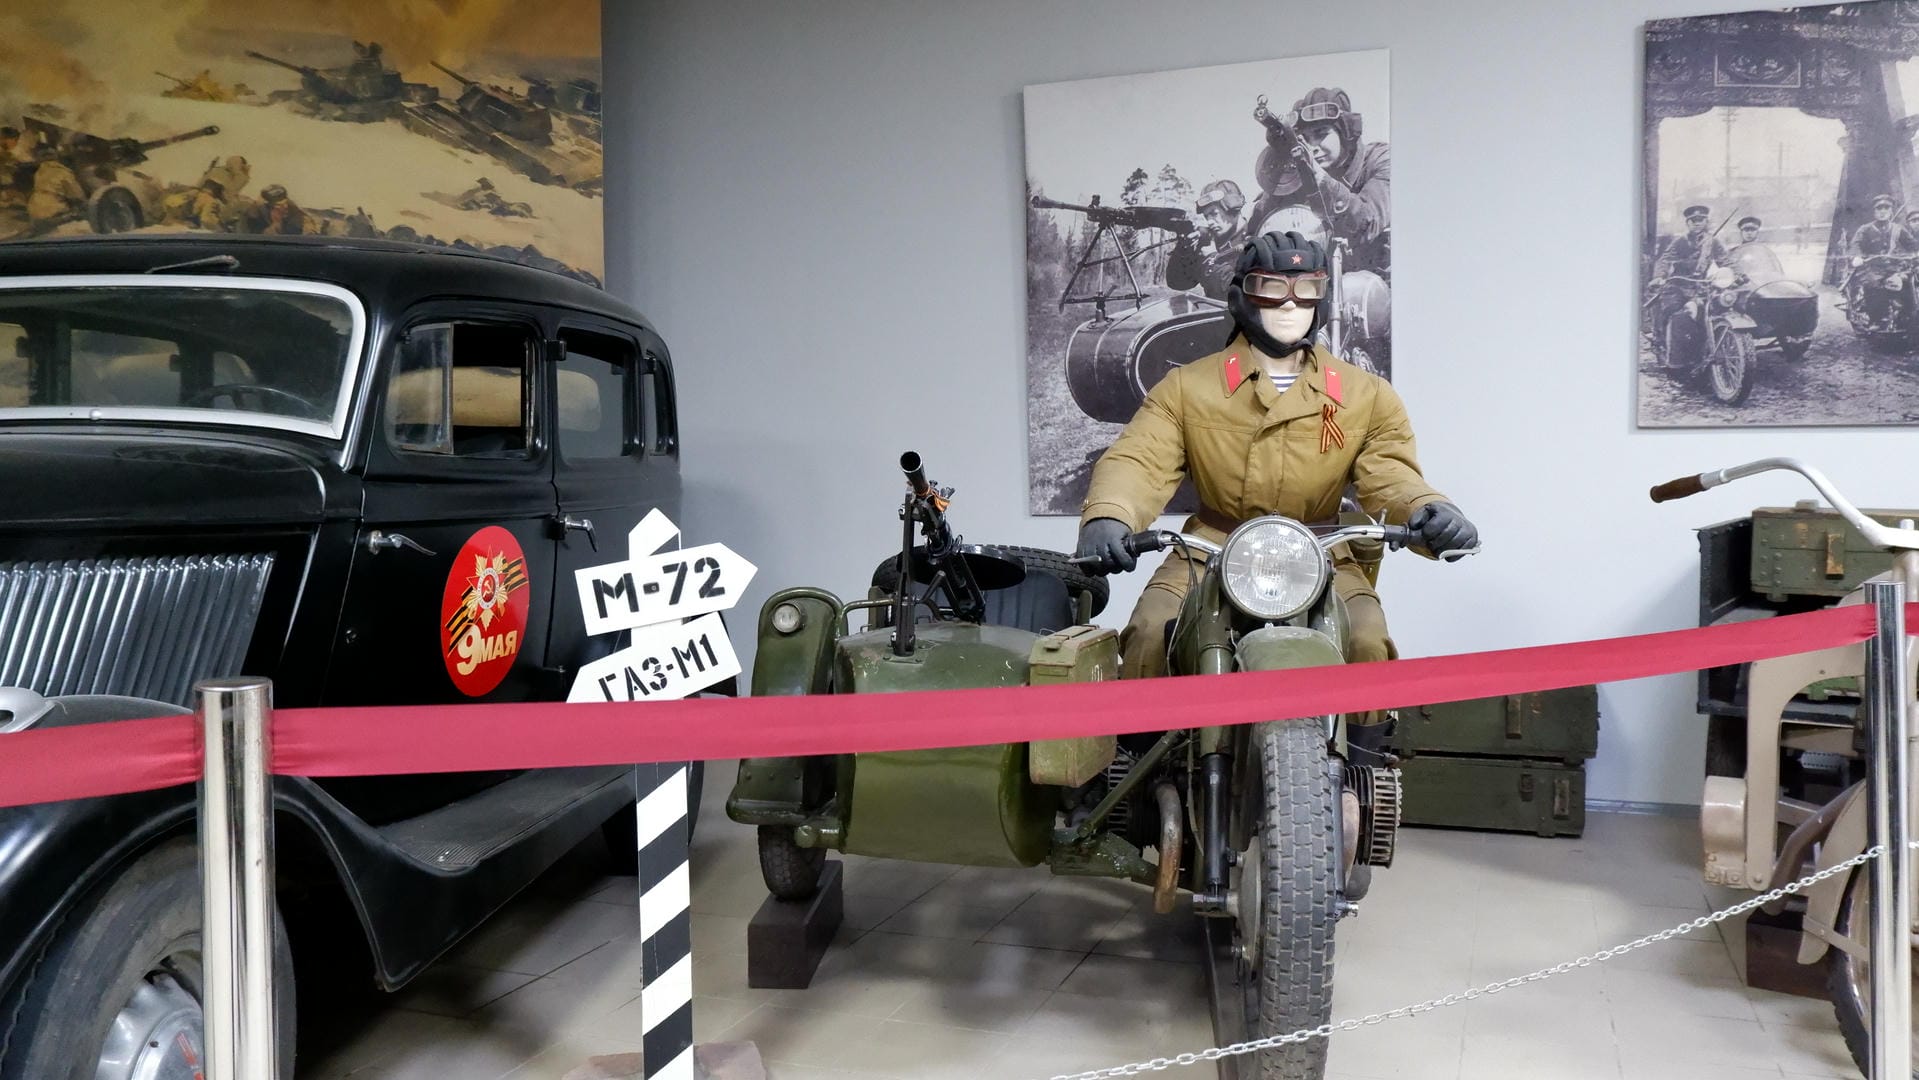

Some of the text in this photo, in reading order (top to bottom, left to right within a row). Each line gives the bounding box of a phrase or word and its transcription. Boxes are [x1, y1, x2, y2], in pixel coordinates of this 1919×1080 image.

[592, 557, 725, 619] М-72
[457, 623, 518, 676] 9 МАЯ
[598, 633, 719, 702] ГАЗ-М1
